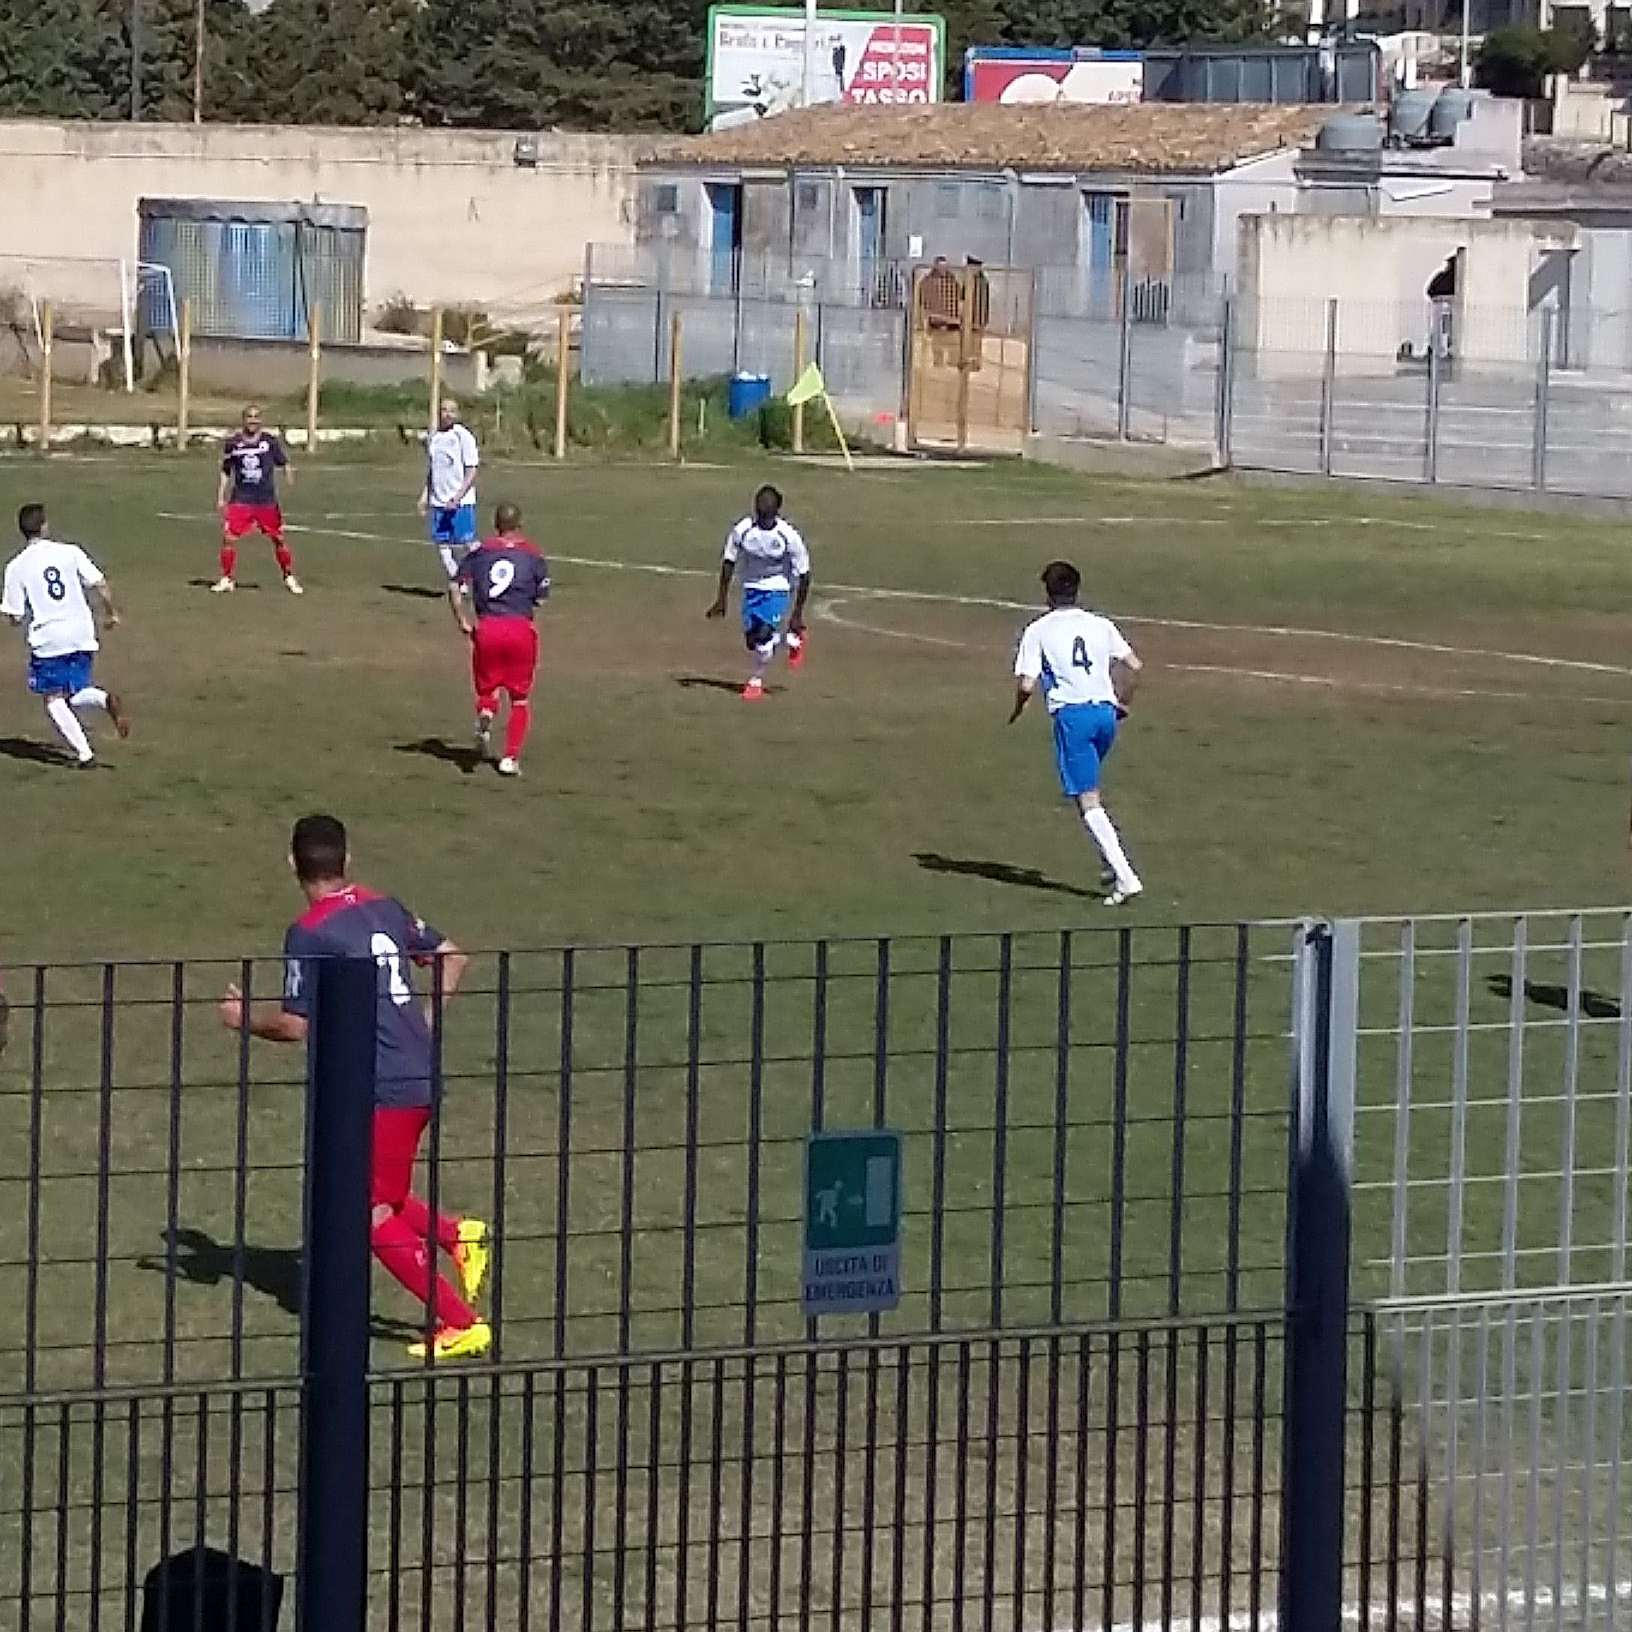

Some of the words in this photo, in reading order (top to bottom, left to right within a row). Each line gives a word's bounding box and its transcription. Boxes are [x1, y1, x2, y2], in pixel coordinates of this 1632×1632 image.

[863, 61, 926, 82] SPOSI
[43, 566, 65, 600] 8
[488, 558, 515, 599] 9
[1072, 635, 1093, 675] 4
[370, 932, 411, 1006] 2
[815, 1256, 868, 1277] USCITA
[873, 1254, 888, 1273] DI
[806, 1278, 894, 1301] EMERGENZA
